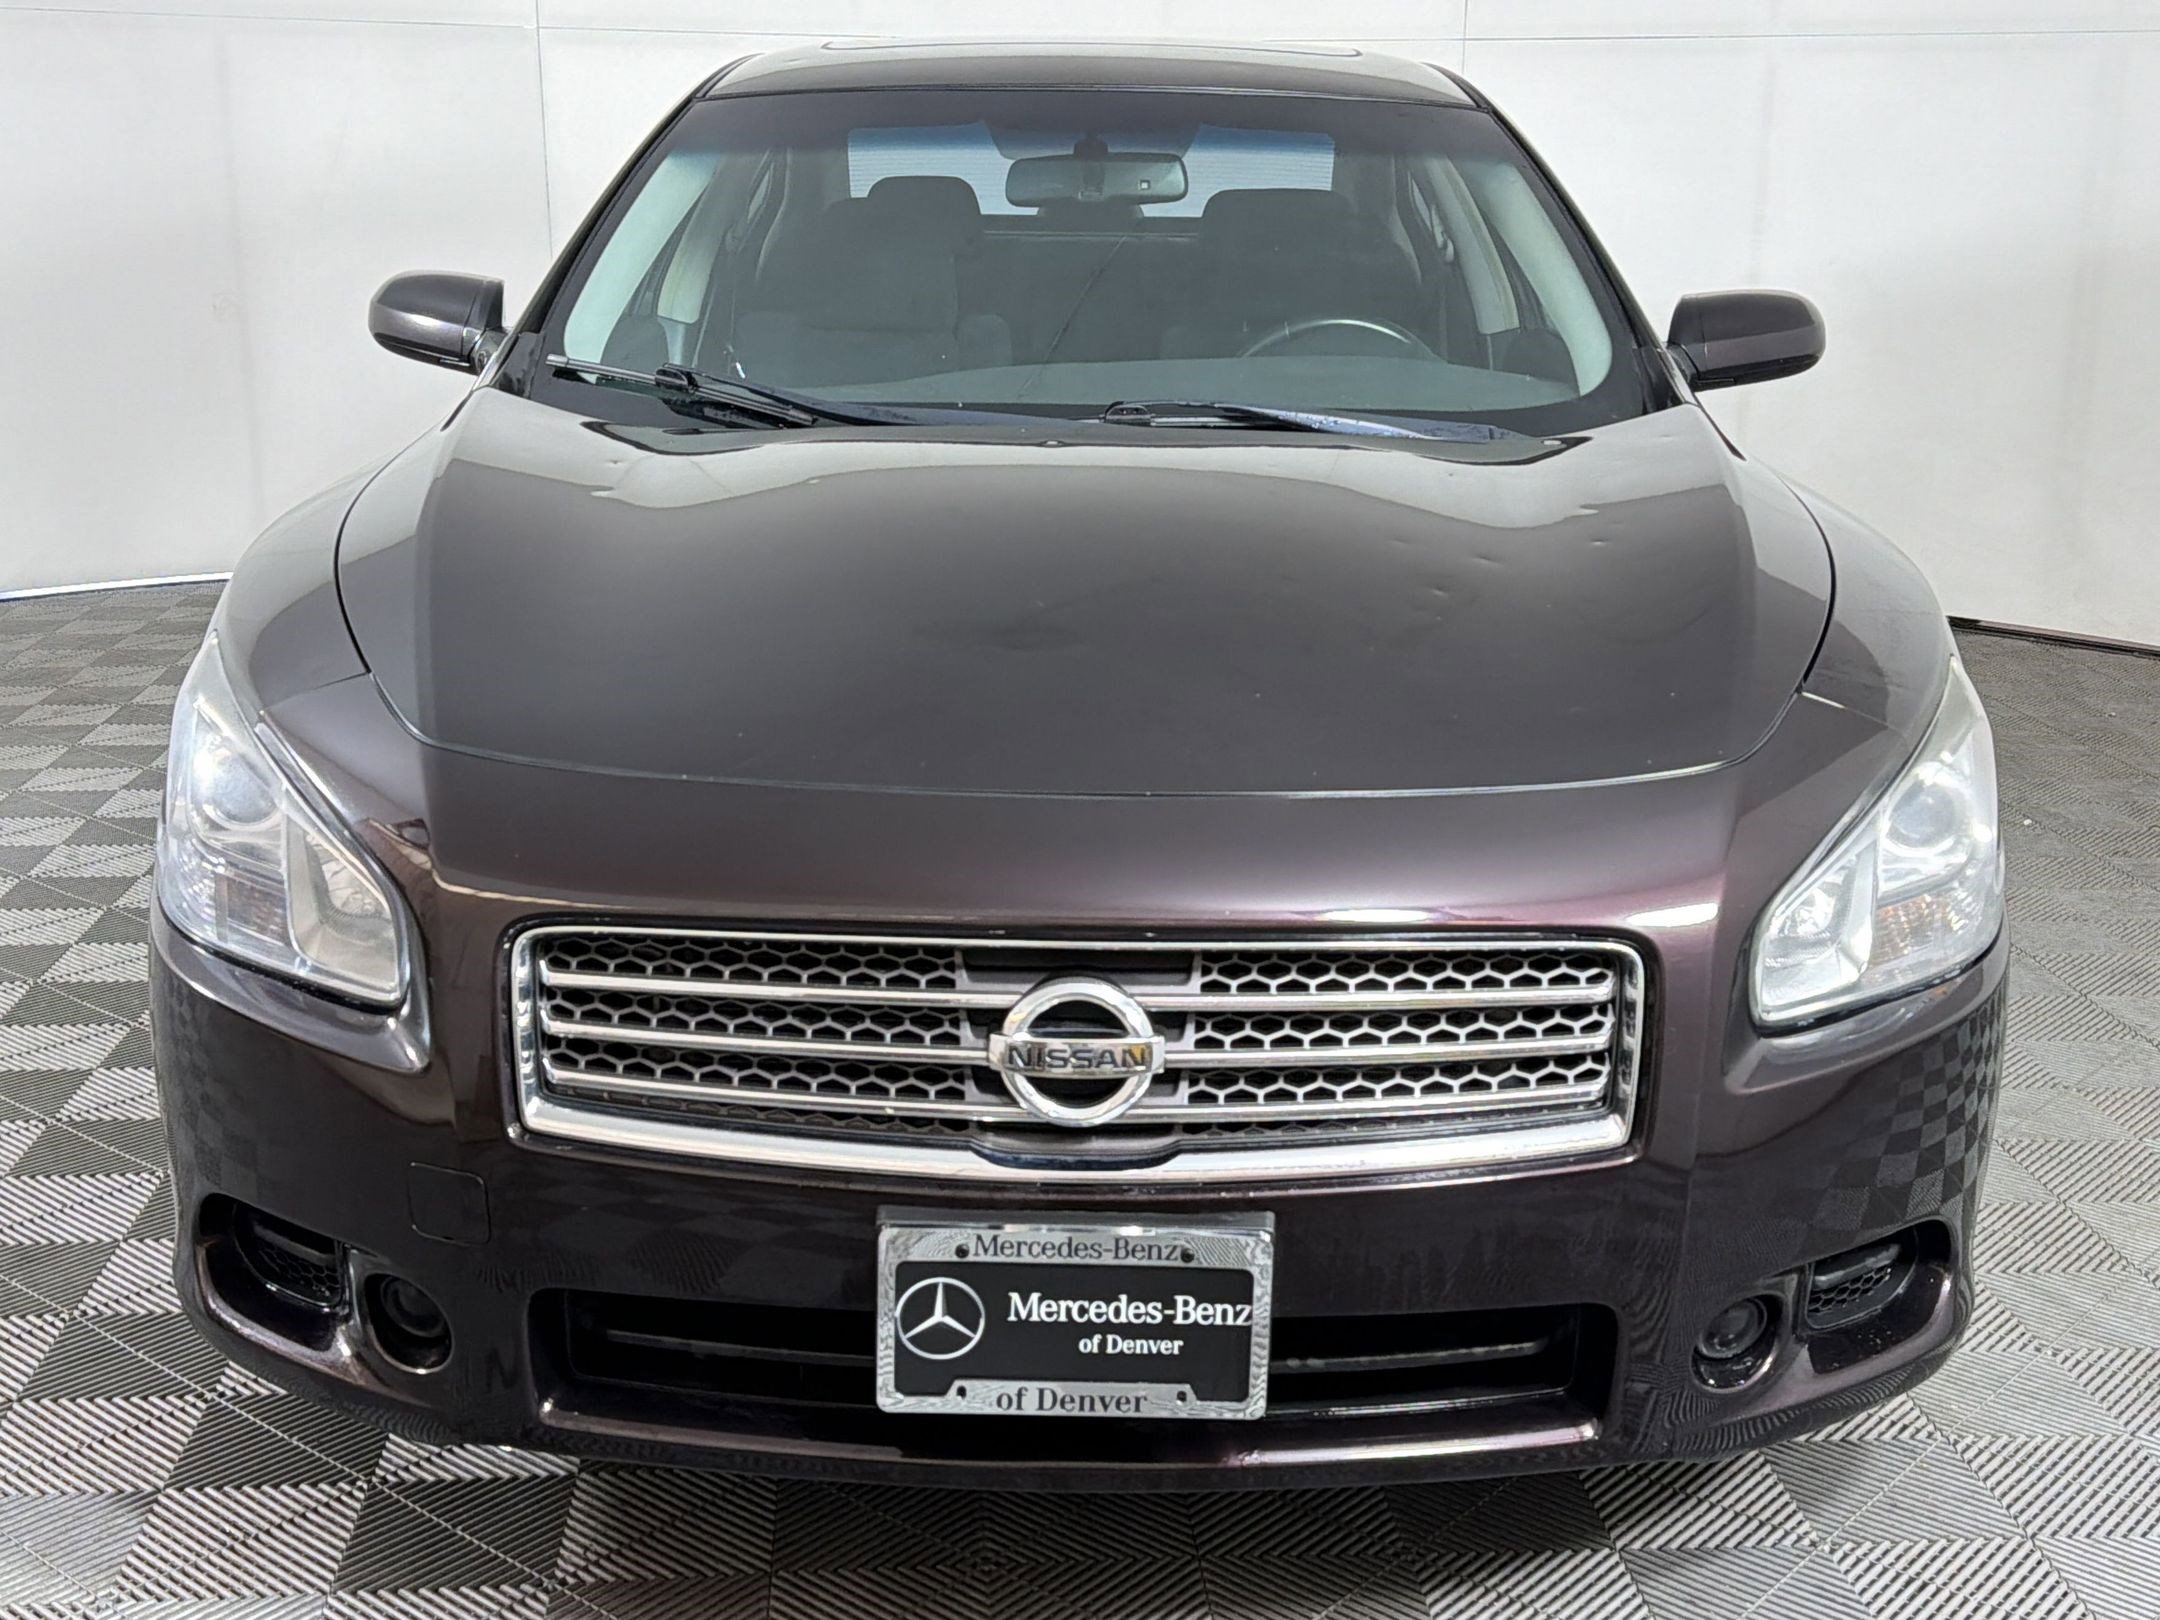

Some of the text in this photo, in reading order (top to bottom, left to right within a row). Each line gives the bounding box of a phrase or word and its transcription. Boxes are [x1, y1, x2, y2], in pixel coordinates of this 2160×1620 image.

[1007, 1045, 1147, 1071] NISSAN
[973, 1233, 1180, 1262] Mercedes-Benz
[1007, 1292, 1252, 1327] Mercedes-Benz
[1078, 1334, 1184, 1355] of Denver
[996, 1387, 1148, 1413] of Denver
